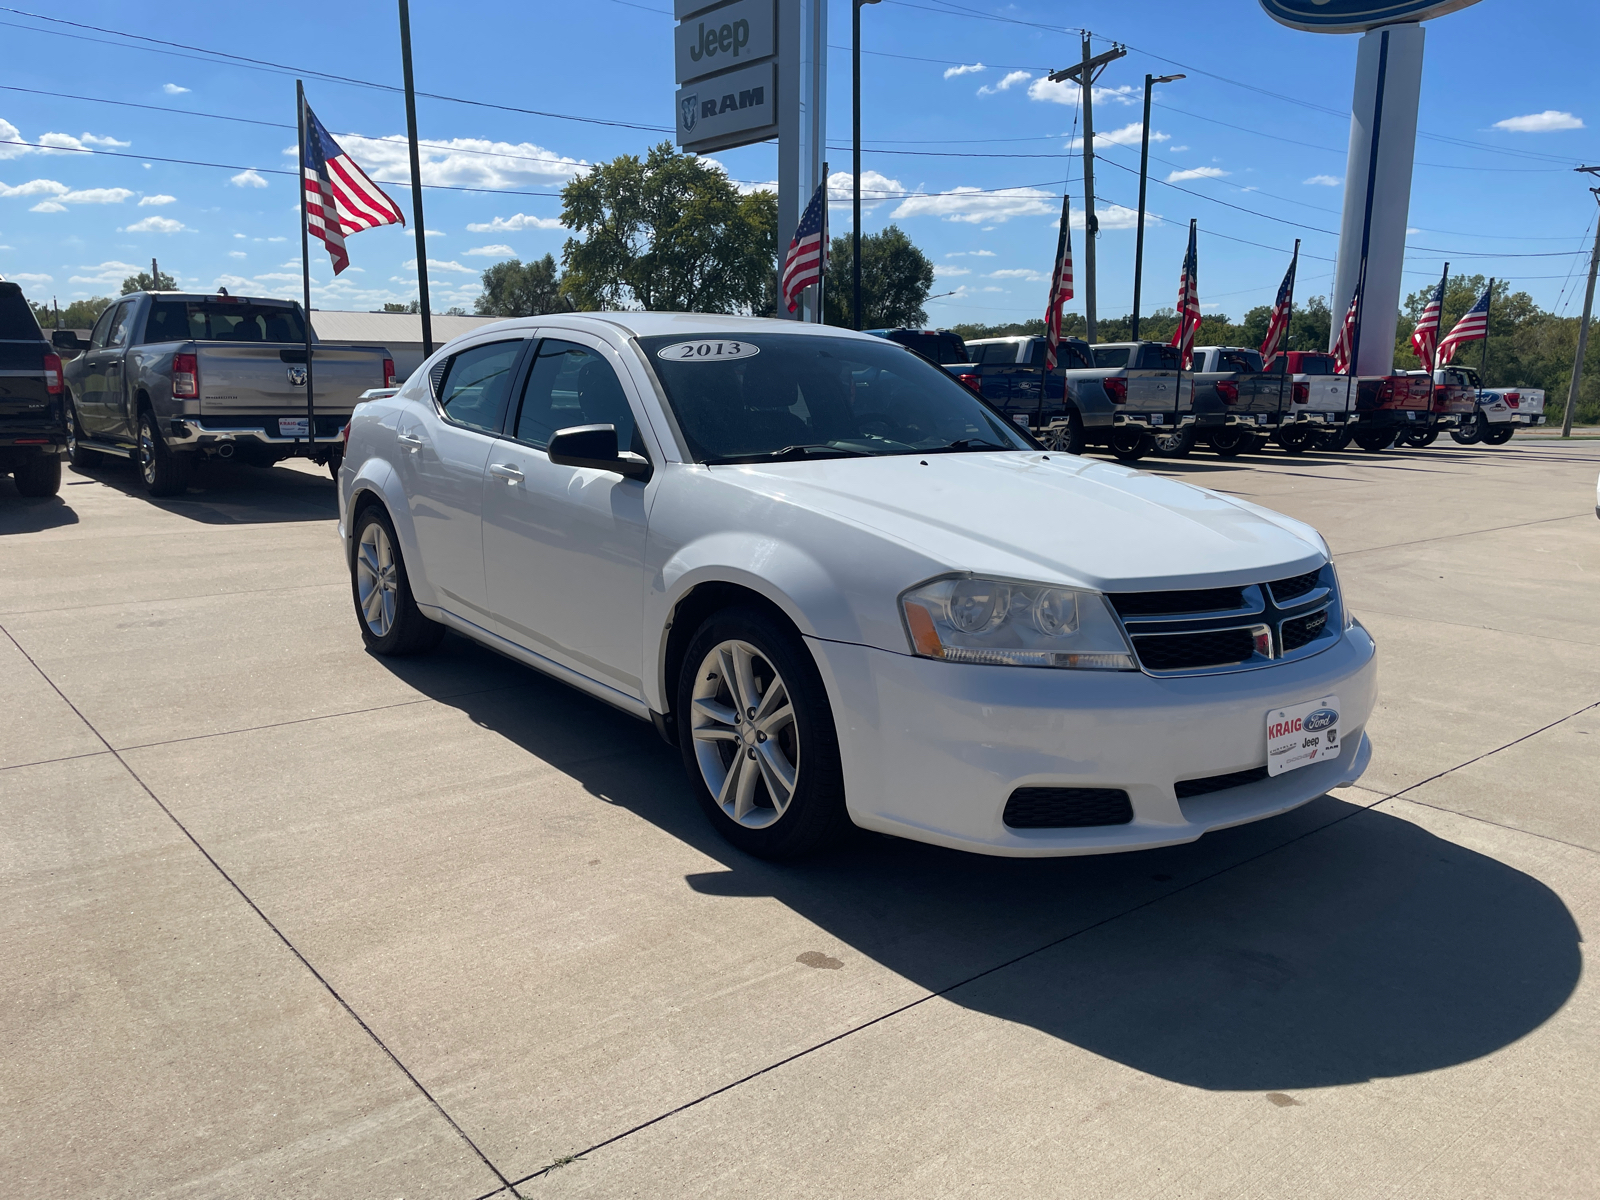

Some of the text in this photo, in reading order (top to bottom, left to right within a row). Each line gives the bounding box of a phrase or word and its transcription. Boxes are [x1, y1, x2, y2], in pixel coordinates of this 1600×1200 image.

[690, 18, 750, 62] Jeep
[701, 86, 765, 119] RAM
[681, 342, 741, 358] 2013
[1268, 711, 1332, 740] KRAIG Ford
[1302, 737, 1320, 748] Jeep
